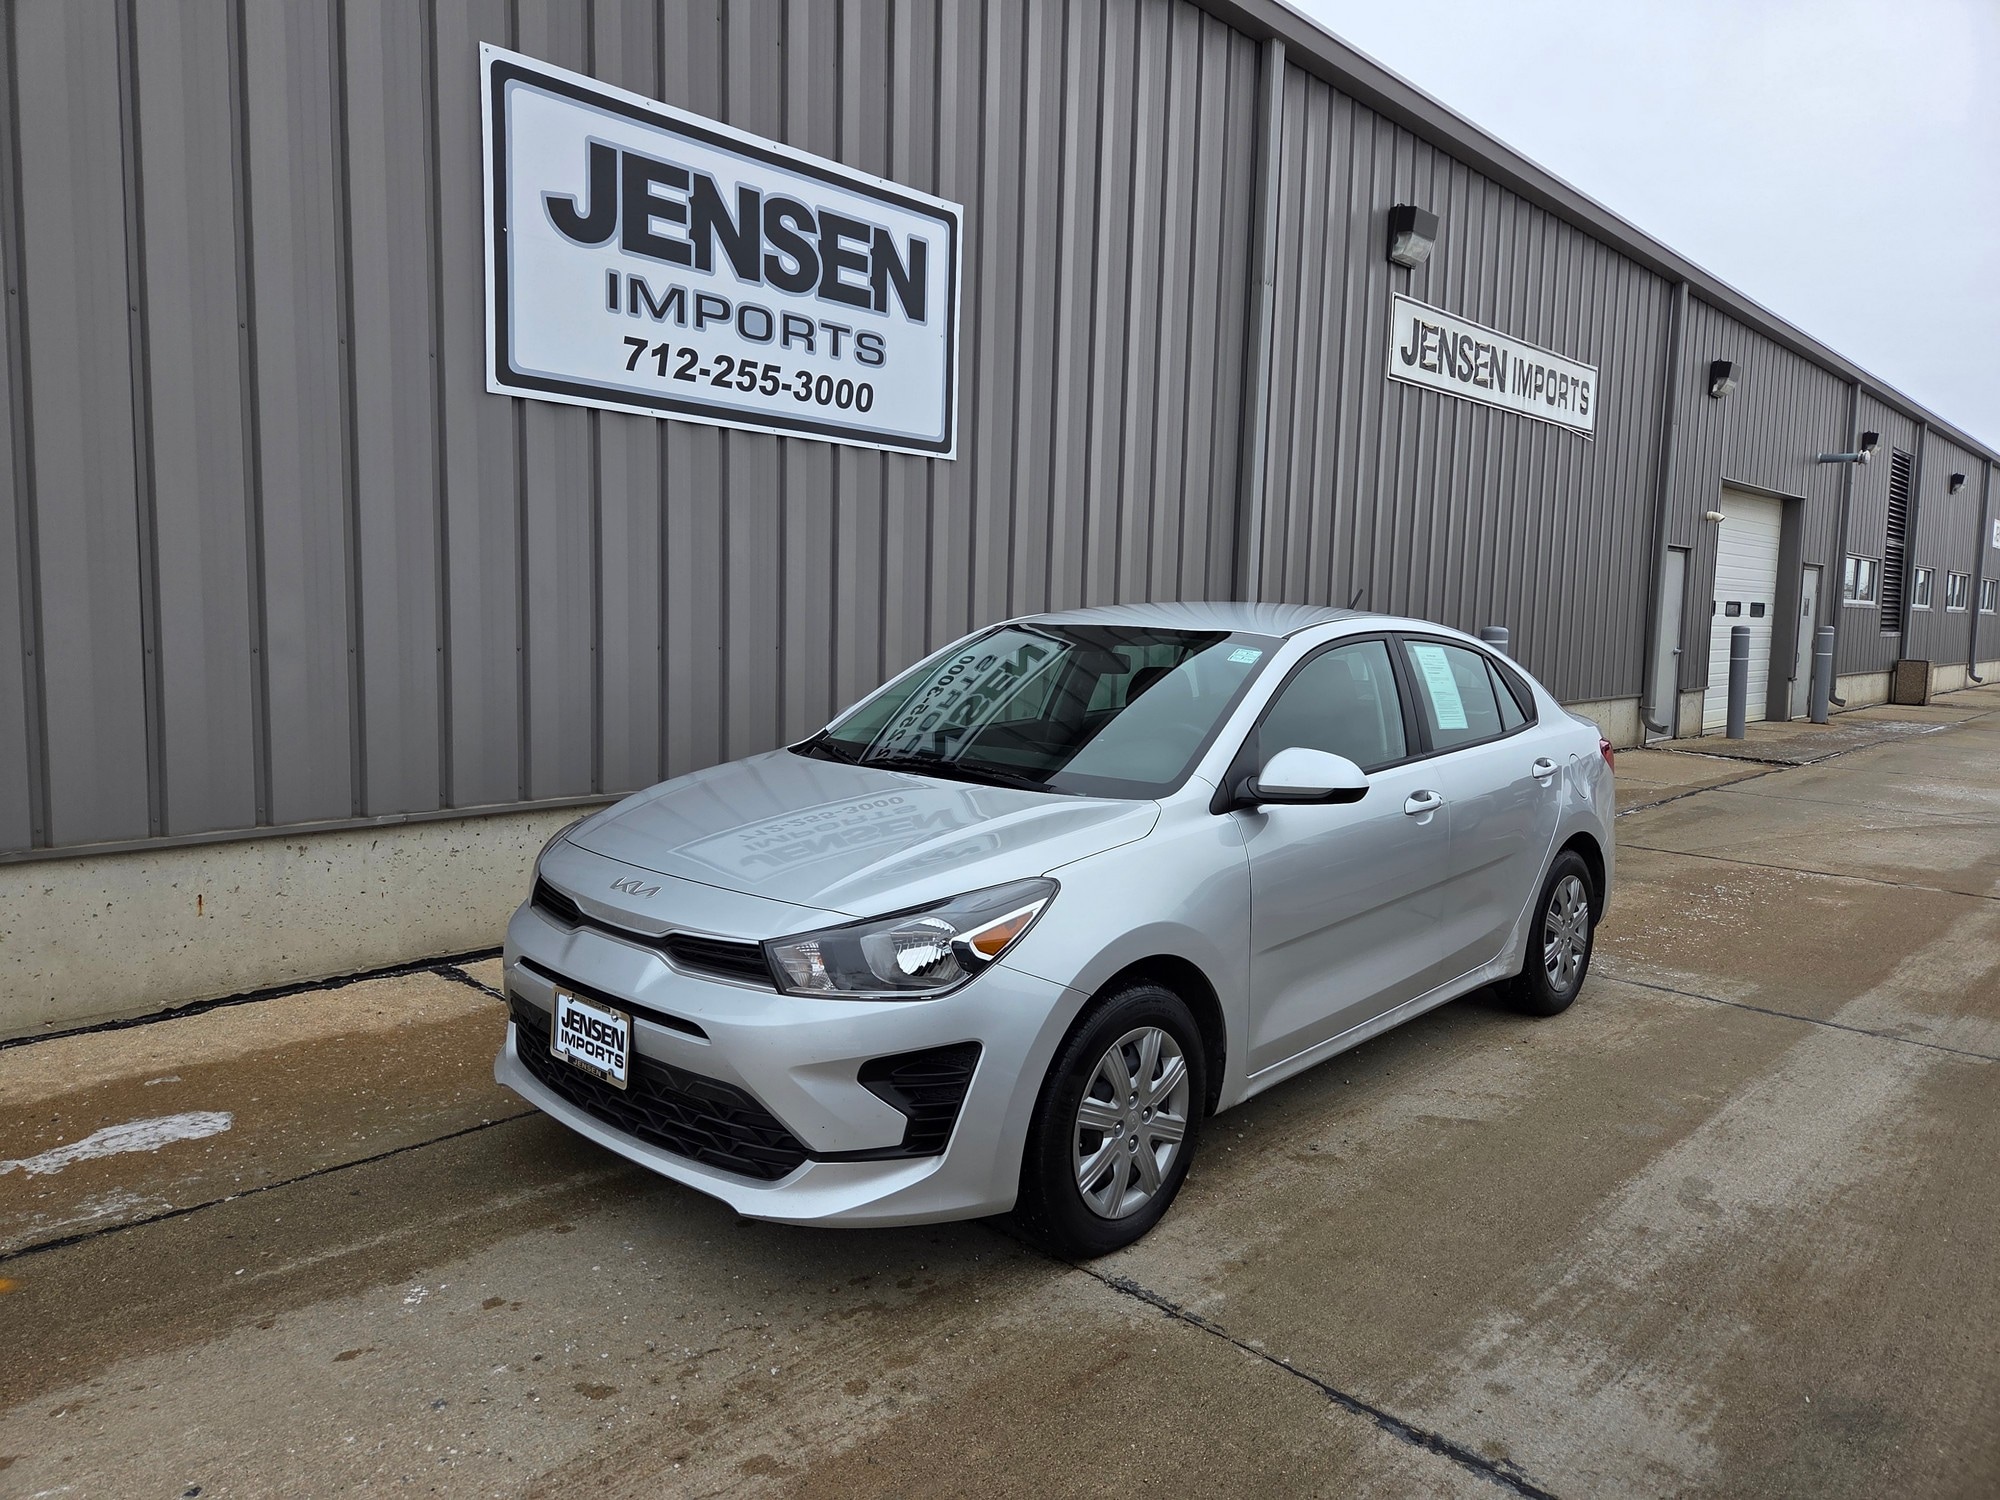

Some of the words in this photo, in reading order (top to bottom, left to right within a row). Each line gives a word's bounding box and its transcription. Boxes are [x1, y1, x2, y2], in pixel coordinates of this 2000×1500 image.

[541, 136, 929, 325] JENSEN
[606, 269, 886, 367] IMPORTS
[622, 336, 874, 413] 712-255-3000
[1401, 318, 1507, 393] JENSEN
[1512, 357, 1590, 415] IMPORTS
[560, 1029, 624, 1069] IMPORTS
[561, 1007, 625, 1052] JENSEN
[572, 1059, 602, 1077] JENSEN
